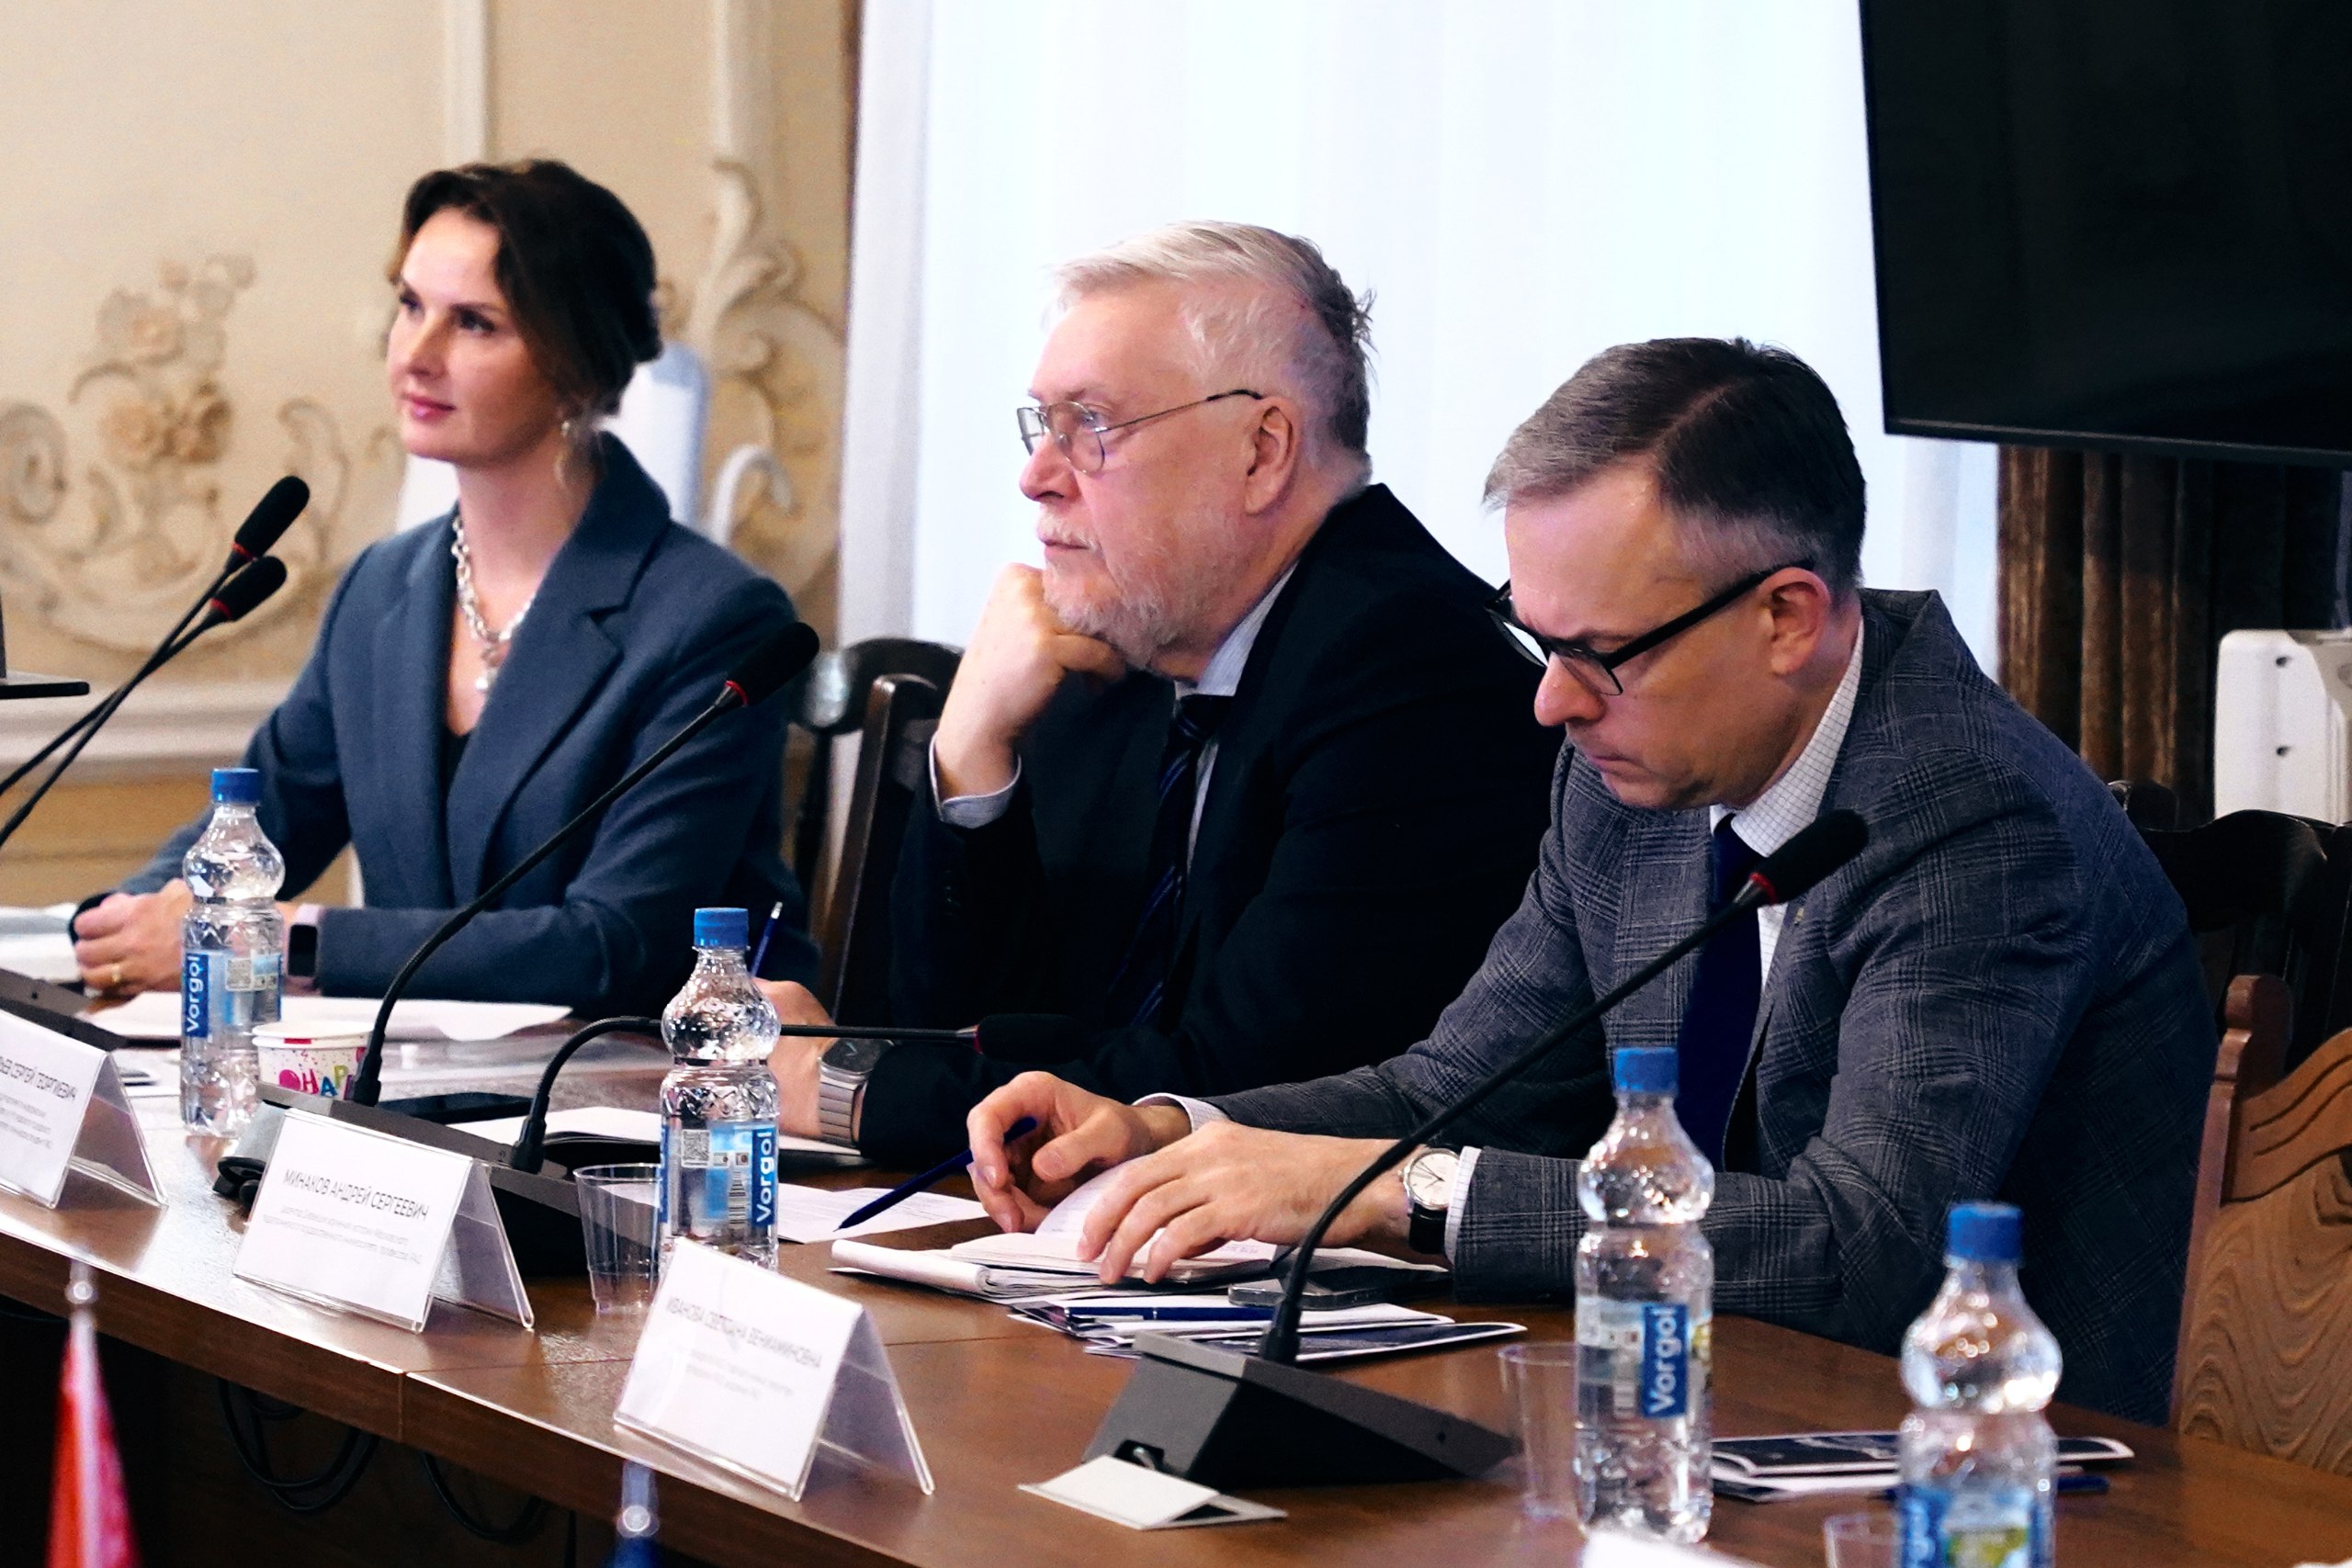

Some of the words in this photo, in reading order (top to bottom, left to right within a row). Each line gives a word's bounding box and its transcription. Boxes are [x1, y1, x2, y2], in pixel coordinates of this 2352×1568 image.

[187, 955, 204, 1032] Vorgol
[283, 1168, 331, 1196] МИНАКОВ
[329, 1180, 373, 1205] АНДРЕЙ
[370, 1191, 430, 1221] СЕРГЕЕВИЧ
[756, 1131, 775, 1223] Vorgol
[1649, 1308, 1682, 1415] Vorgol
